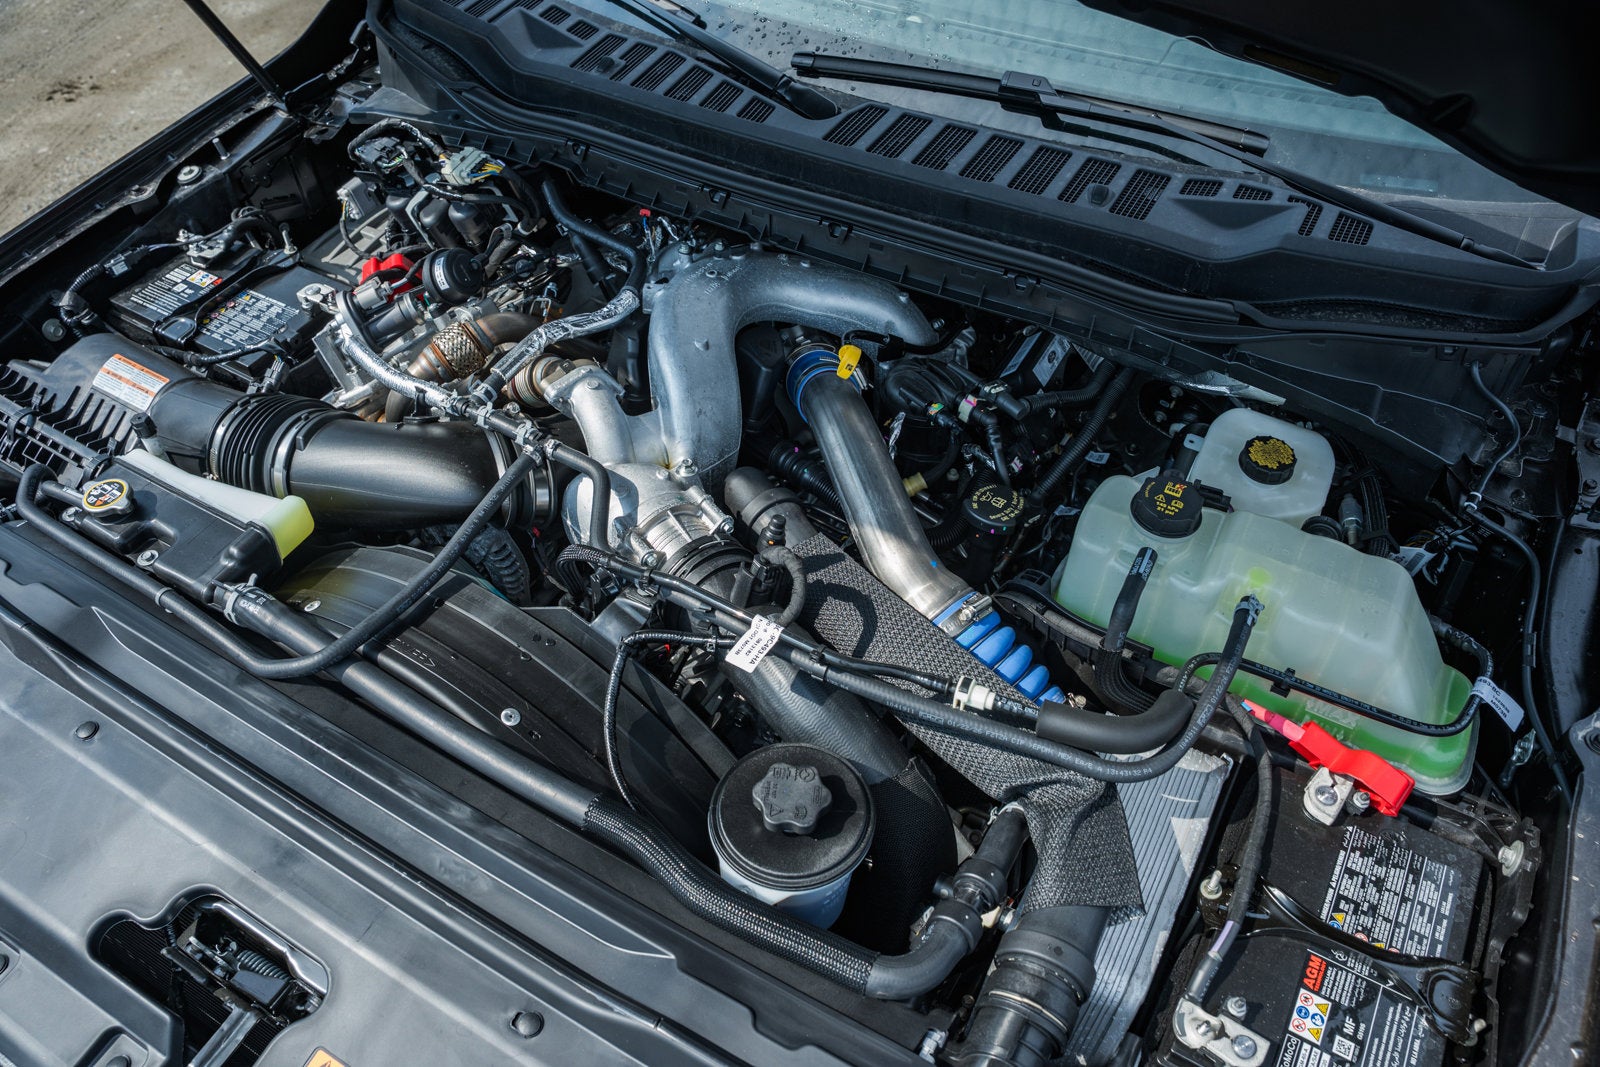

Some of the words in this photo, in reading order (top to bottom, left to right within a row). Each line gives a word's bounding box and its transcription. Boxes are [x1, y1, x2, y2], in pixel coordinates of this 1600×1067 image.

[1304, 955, 1321, 989] AGM
[1343, 1016, 1355, 1035] MF
[1280, 1037, 1298, 1067] oMoCo
